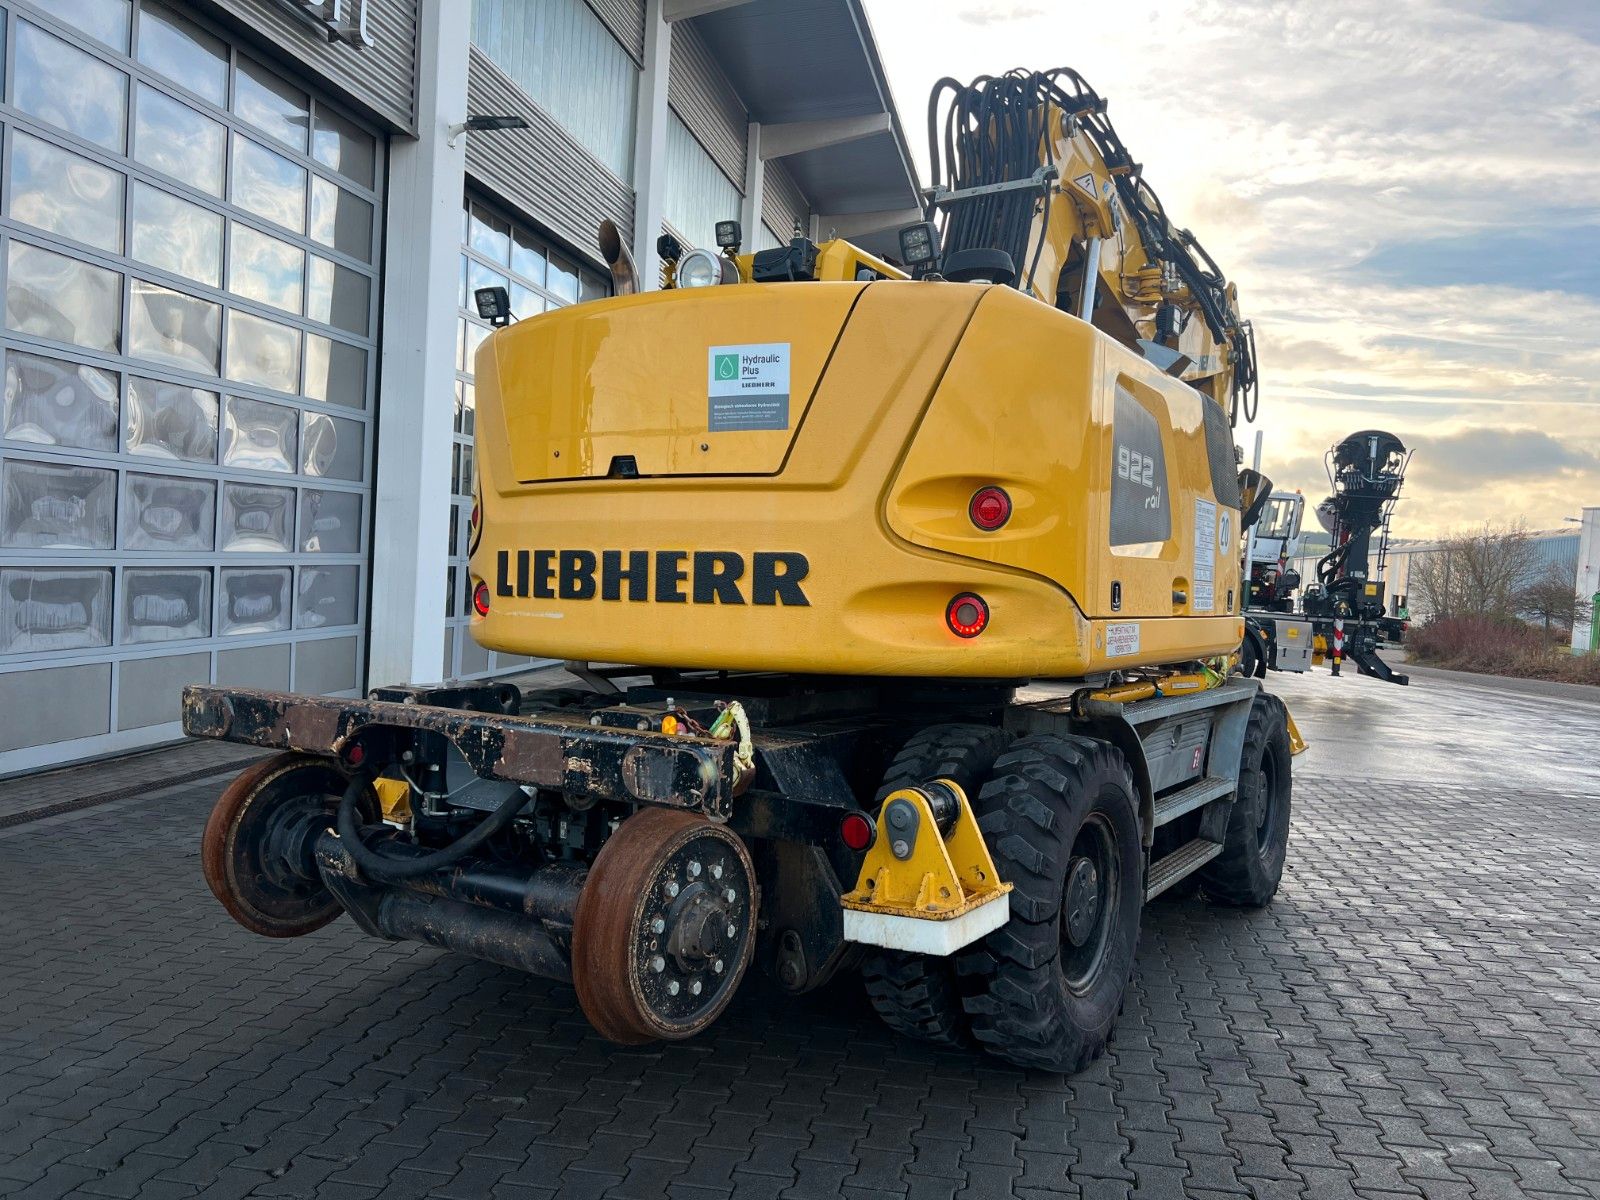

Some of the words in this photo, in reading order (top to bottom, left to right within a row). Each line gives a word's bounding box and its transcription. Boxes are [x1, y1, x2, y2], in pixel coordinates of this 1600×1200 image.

[742, 354, 780, 365] Hydraulic
[742, 366, 760, 375] Plus
[1118, 445, 1154, 488] 922
[1145, 486, 1161, 509] rail
[1220, 516, 1229, 546] 20
[497, 550, 812, 607] LIEBHERR
